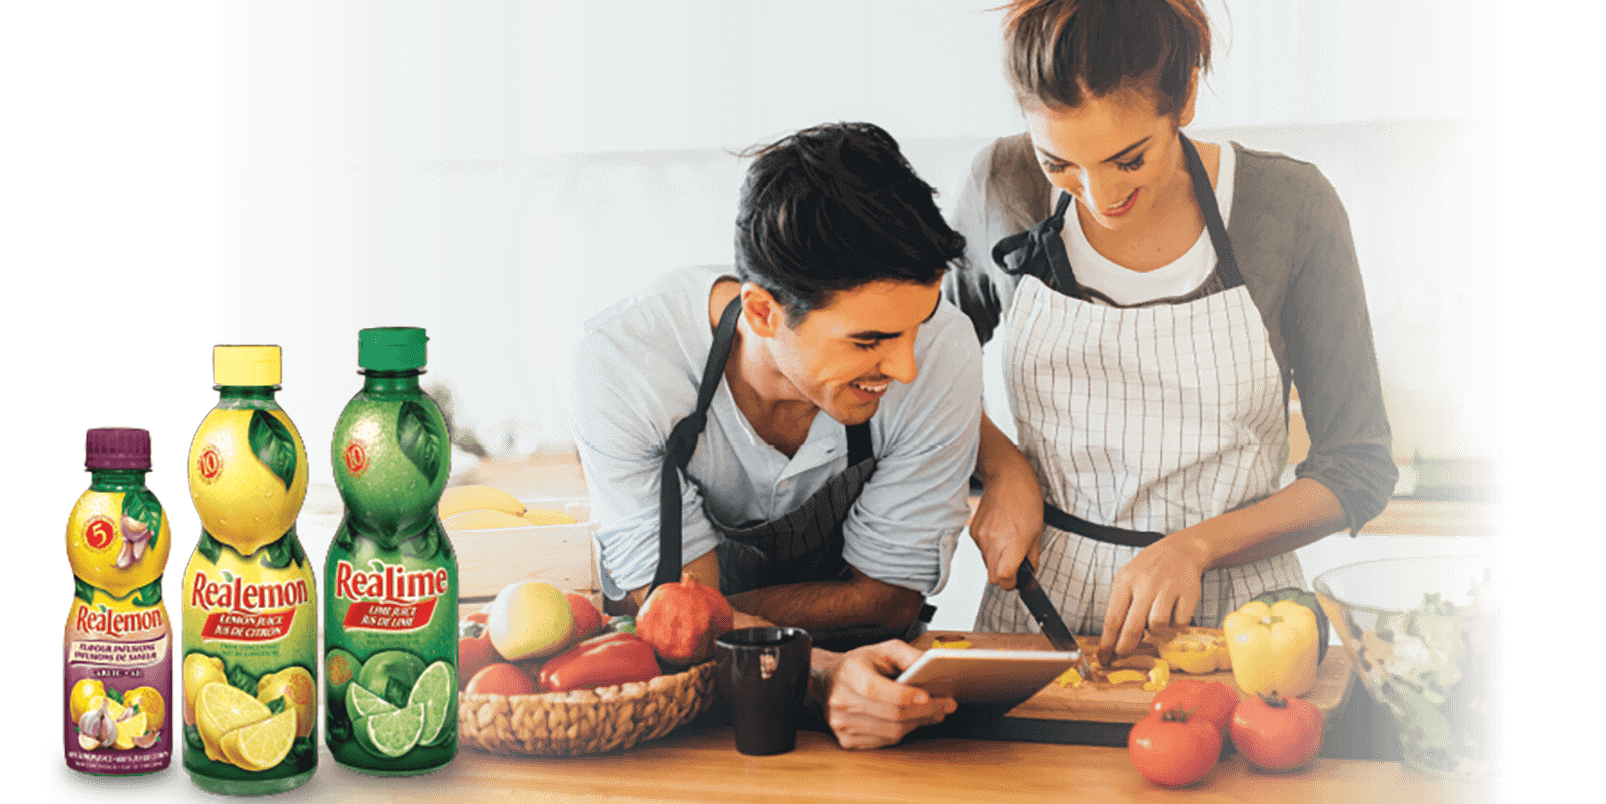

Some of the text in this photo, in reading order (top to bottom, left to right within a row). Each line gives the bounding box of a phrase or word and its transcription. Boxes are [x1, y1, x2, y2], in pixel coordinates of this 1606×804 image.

[93, 523, 107, 547] 5
[191, 572, 308, 615] ReaLemon
[336, 562, 449, 604] ReaLime
[76, 605, 162, 638] ReaLemon
